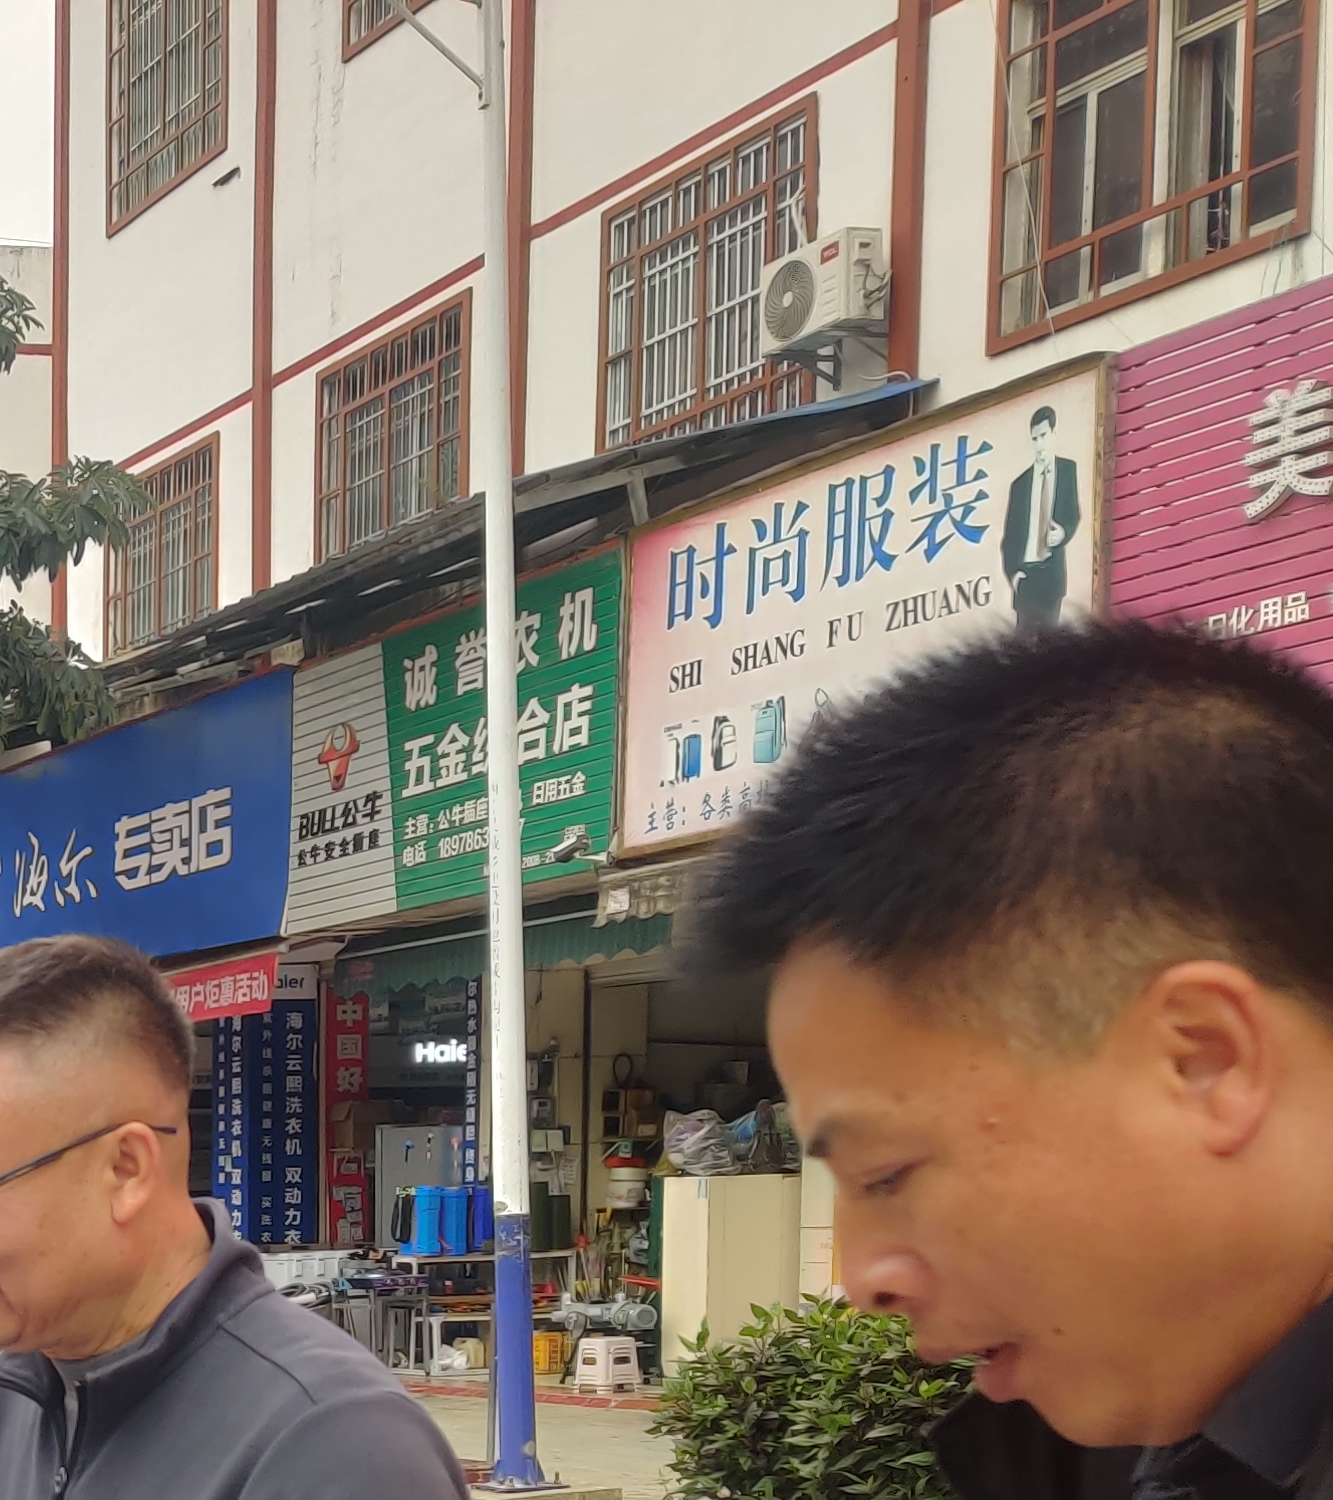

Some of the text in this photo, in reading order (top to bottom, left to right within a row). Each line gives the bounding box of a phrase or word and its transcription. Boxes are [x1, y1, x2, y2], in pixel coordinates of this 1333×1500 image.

[1243, 380, 1333, 519] 美
[666, 435, 996, 632] 时尚服装
[669, 659, 703, 695] SHI
[731, 629, 807, 676] SHANG
[885, 575, 993, 634] ZHUANG
[114, 786, 232, 893] 专卖店
[402, 839, 427, 867] 电话
[274, 973, 305, 990] aier
[284, 1011, 304, 1156] 海尔云熙洗衣机
[415, 1038, 467, 1064] Haie
